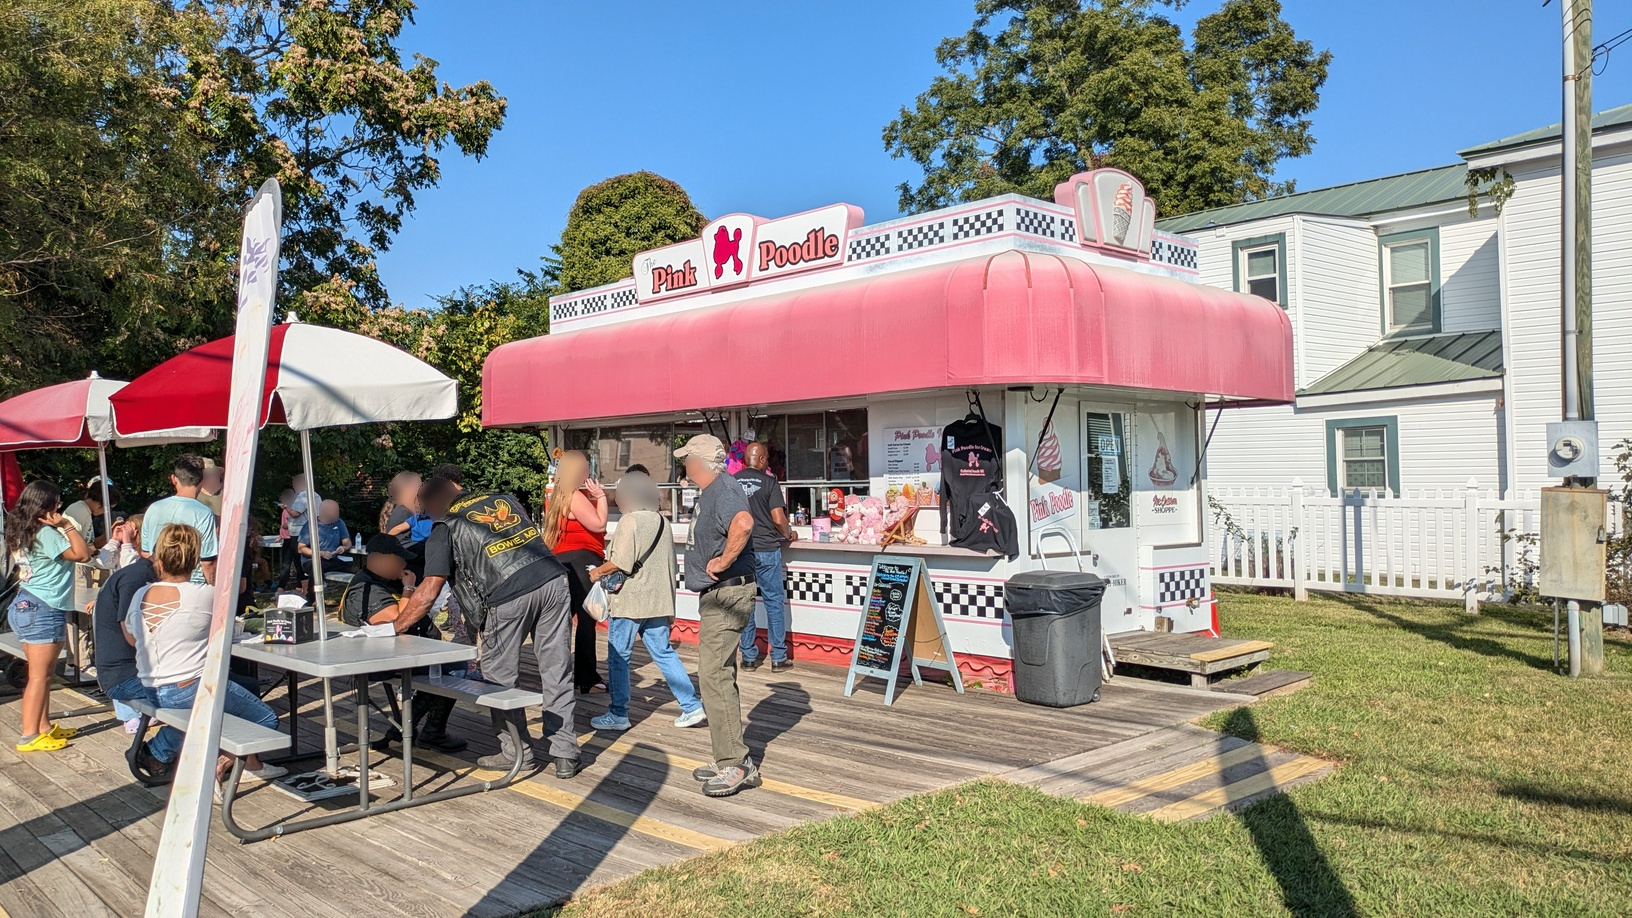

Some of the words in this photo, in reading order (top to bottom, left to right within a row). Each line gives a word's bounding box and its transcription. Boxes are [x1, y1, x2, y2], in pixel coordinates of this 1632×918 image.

[652, 259, 698, 294] Pink
[759, 226, 839, 271] Poodle
[912, 429, 935, 440] Poodle
[1100, 439, 1119, 451] OPEN
[1030, 495, 1050, 522] Pink
[1049, 487, 1074, 514] Poodle
[489, 536, 525, 553] BOWIE,
[523, 530, 537, 539] MD
